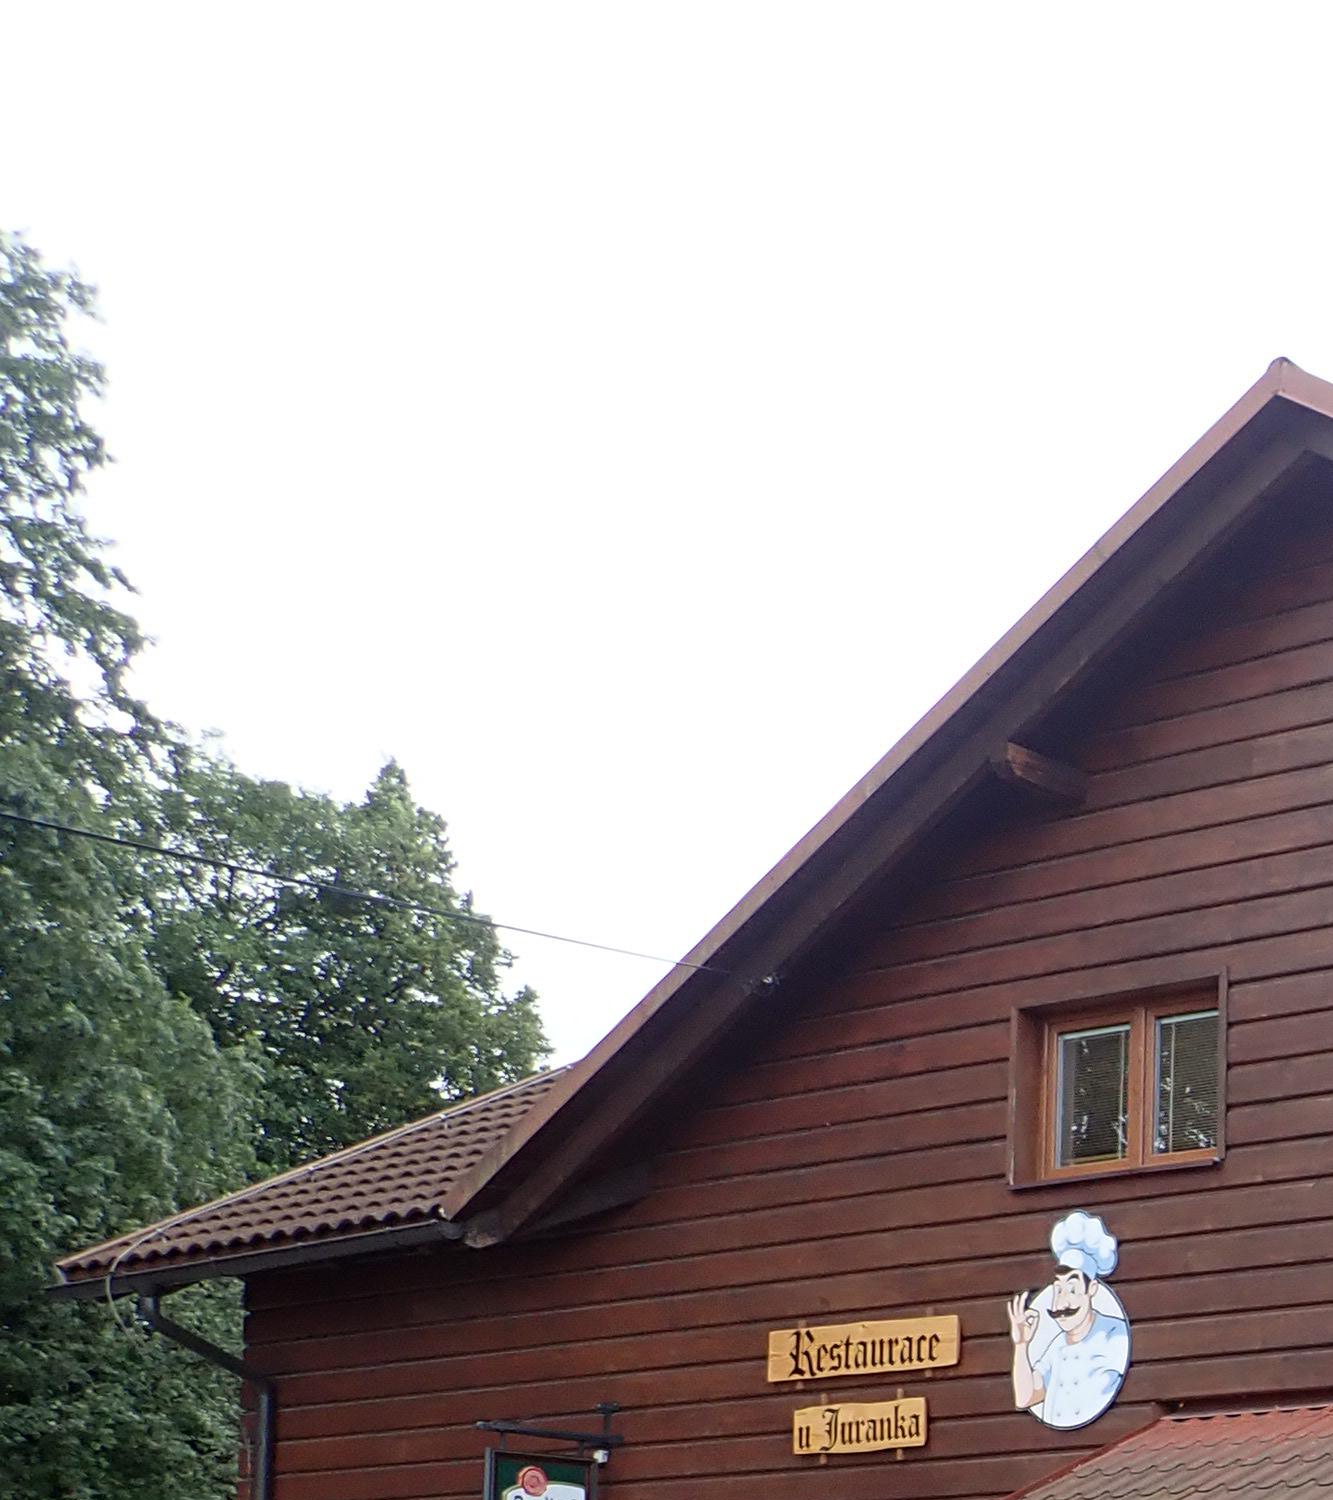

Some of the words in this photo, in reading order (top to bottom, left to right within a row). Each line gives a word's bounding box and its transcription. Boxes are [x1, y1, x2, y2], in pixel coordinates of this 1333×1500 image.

[788, 1330, 940, 1377] Restaurace
[798, 1424, 811, 1449] u
[818, 1405, 921, 1451] Juranka
